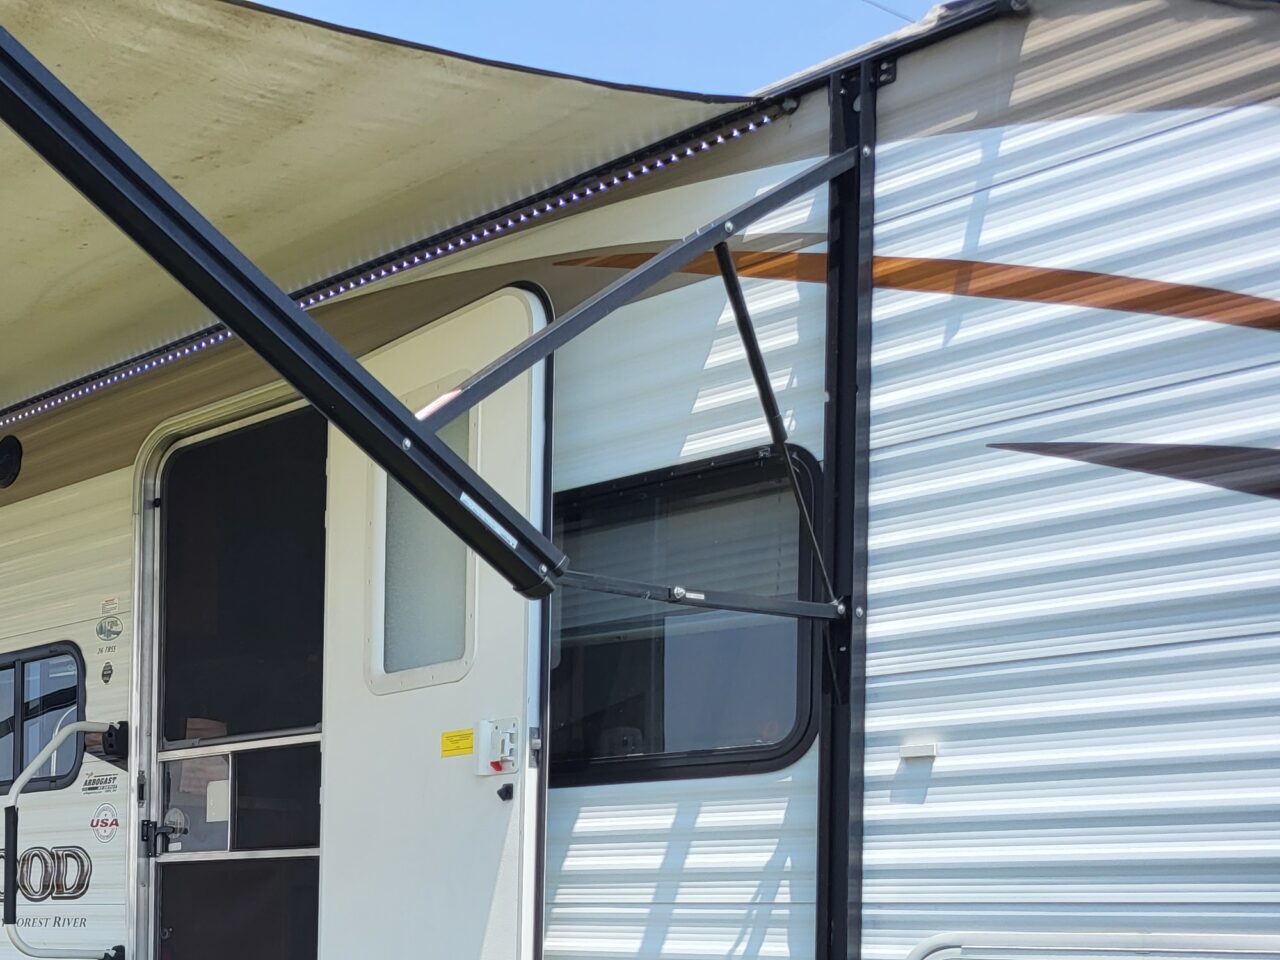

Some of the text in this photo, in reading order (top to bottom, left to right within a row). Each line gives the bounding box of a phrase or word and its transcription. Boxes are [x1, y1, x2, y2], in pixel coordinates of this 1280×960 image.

[83, 777, 117, 786] ARBOGAST
[90, 818, 119, 828] USA
[15, 917, 51, 928] OREST
[52, 915, 87, 928] RIVER
